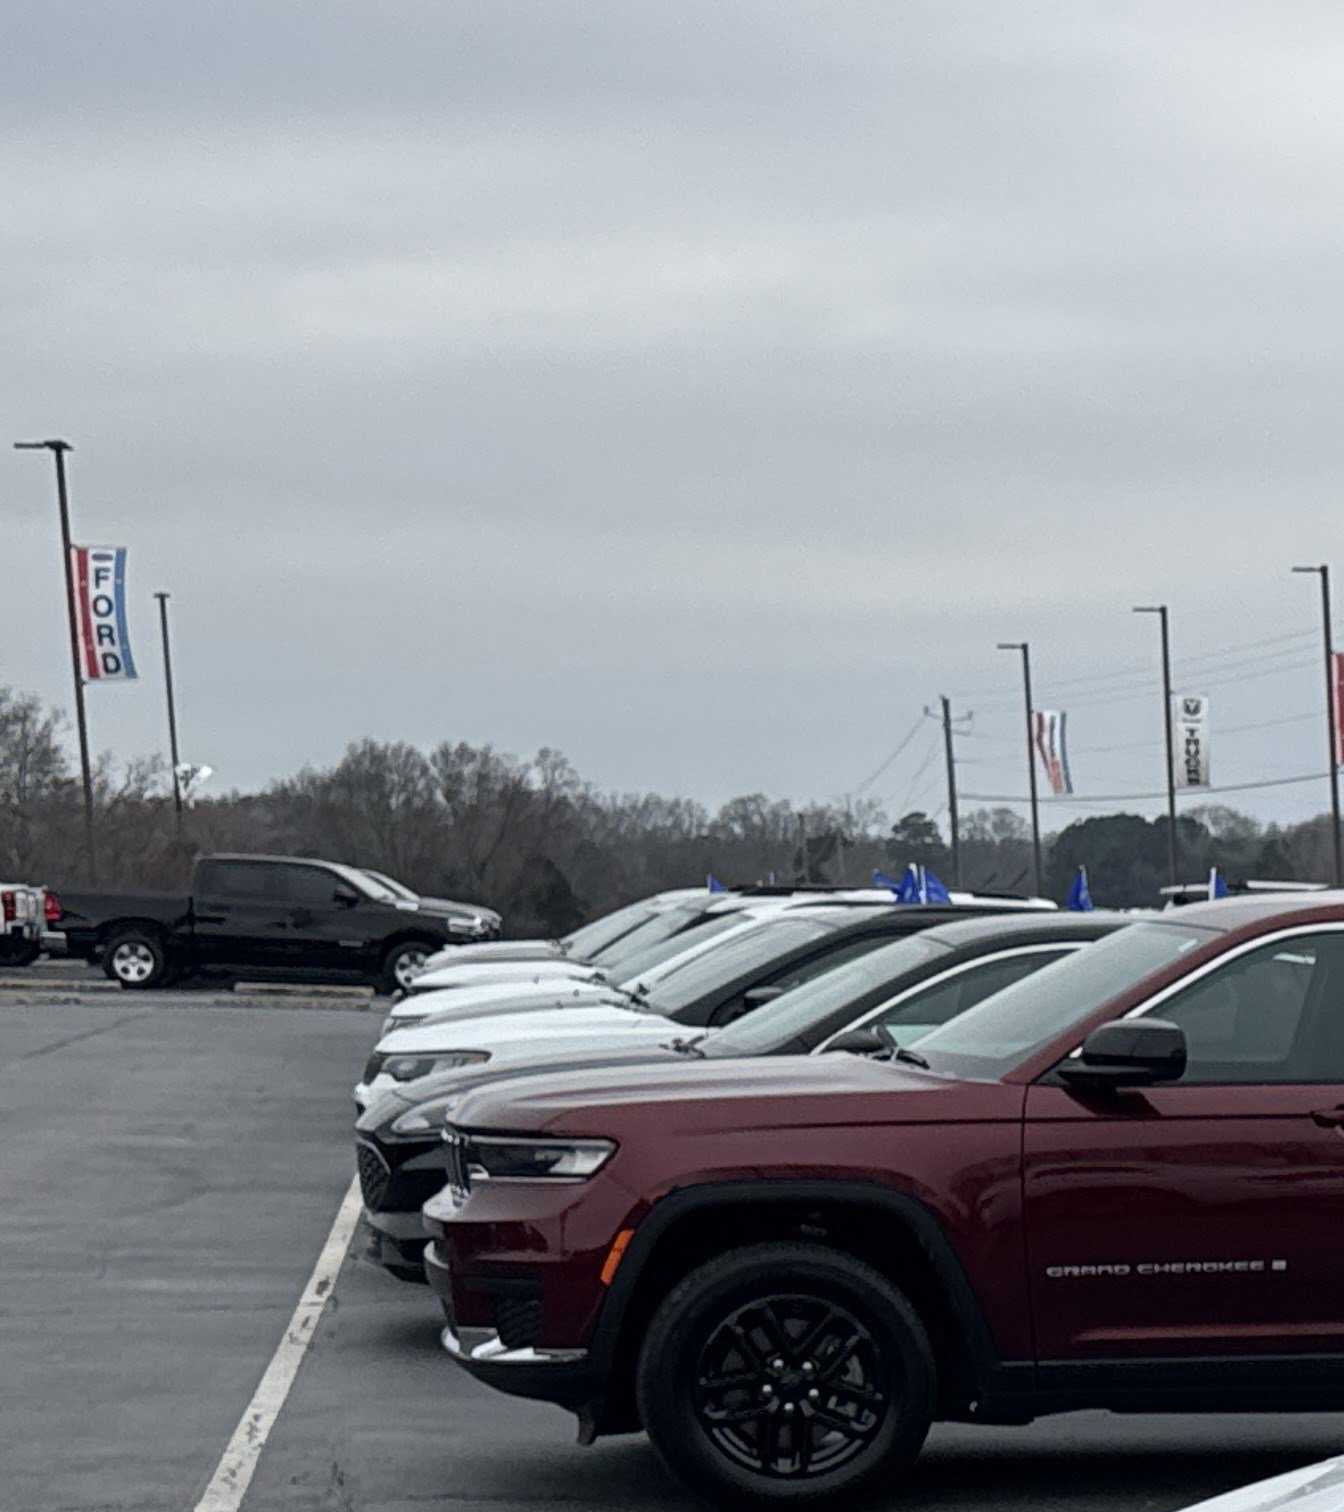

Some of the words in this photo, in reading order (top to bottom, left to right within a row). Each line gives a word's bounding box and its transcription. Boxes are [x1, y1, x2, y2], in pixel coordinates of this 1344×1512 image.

[92, 566, 122, 675] FORD
[1045, 1263, 1131, 1278] GRAND
[1136, 1259, 1265, 1275] CHEROKEE
